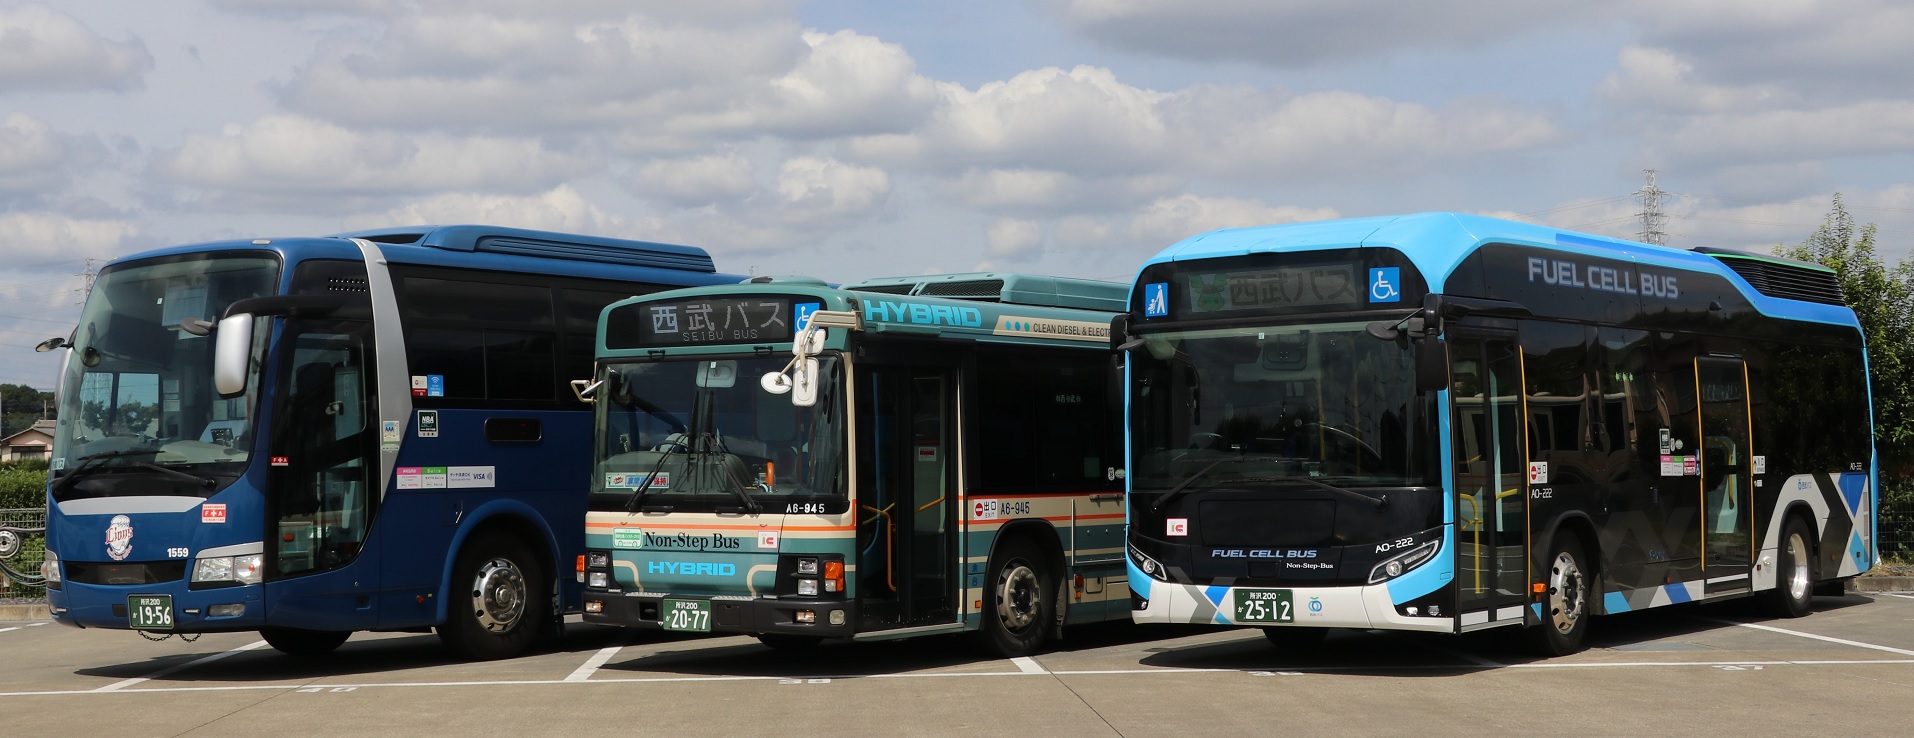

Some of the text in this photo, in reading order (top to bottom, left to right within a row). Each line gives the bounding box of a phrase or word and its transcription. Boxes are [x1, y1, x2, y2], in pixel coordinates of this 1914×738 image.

[1527, 256, 1679, 299] FUEL CELL BUS
[1229, 269, 1356, 306] 西武バス
[650, 302, 785, 334] 西武バス
[863, 299, 982, 327] HYBRID
[682, 329, 758, 342] SEIBU BUS
[1033, 322, 1056, 334] CLEAN
[1057, 324, 1080, 336] DIESEL
[1082, 326, 1087, 336] &
[786, 503, 825, 513] A6-945
[983, 501, 997, 511] 出口
[1000, 501, 1030, 515] A6-945
[106, 526, 133, 544] Lions
[644, 532, 740, 551] Non-Step Bus
[167, 547, 189, 558] 1559
[1211, 549, 1317, 558] FUEL CELL BUS
[648, 561, 736, 576] HYBRID
[1286, 562, 1334, 570] Non-Step-Bus
[139, 606, 171, 625] 19-56
[1244, 600, 1291, 620] 25-12
[671, 609, 709, 630] 20-77
